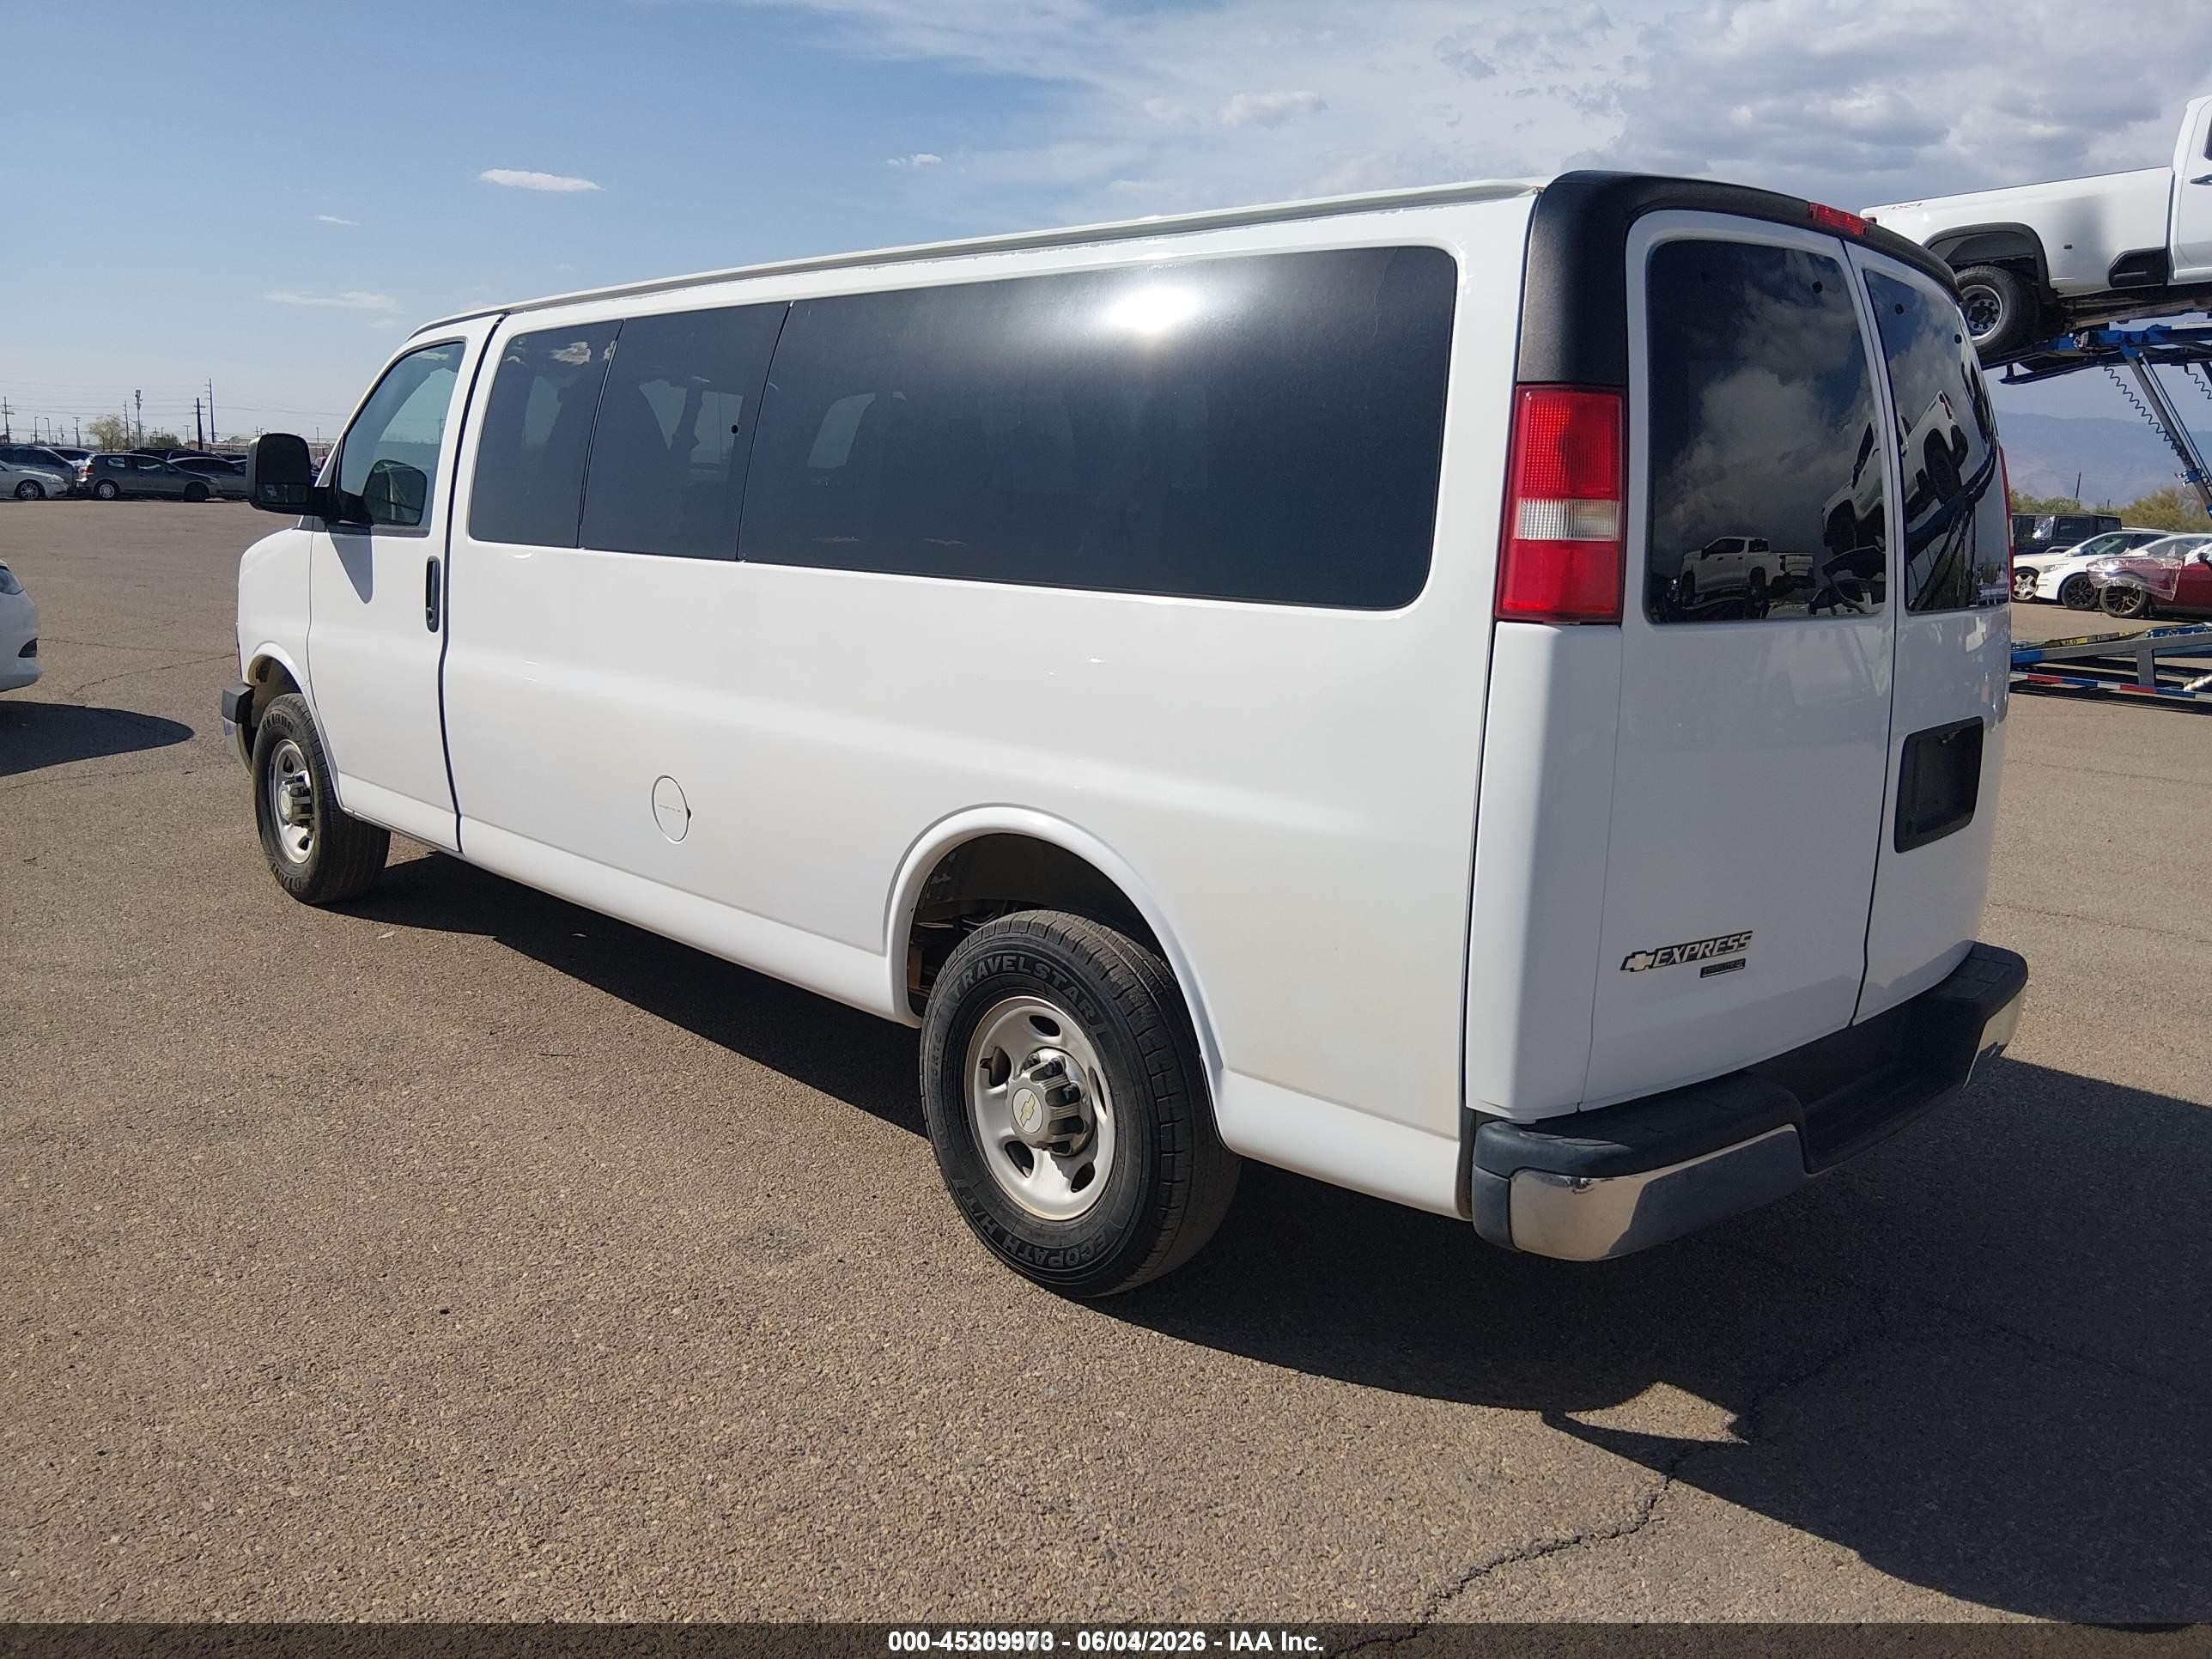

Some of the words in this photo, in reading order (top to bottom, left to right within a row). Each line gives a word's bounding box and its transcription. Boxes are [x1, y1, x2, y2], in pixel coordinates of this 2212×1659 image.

[1654, 932, 1752, 968] EXPRESS
[951, 955, 1097, 1021] TRAVELSTAR
[961, 1192, 999, 1234] H/T
[1002, 1230, 1107, 1268] ECOPATH
